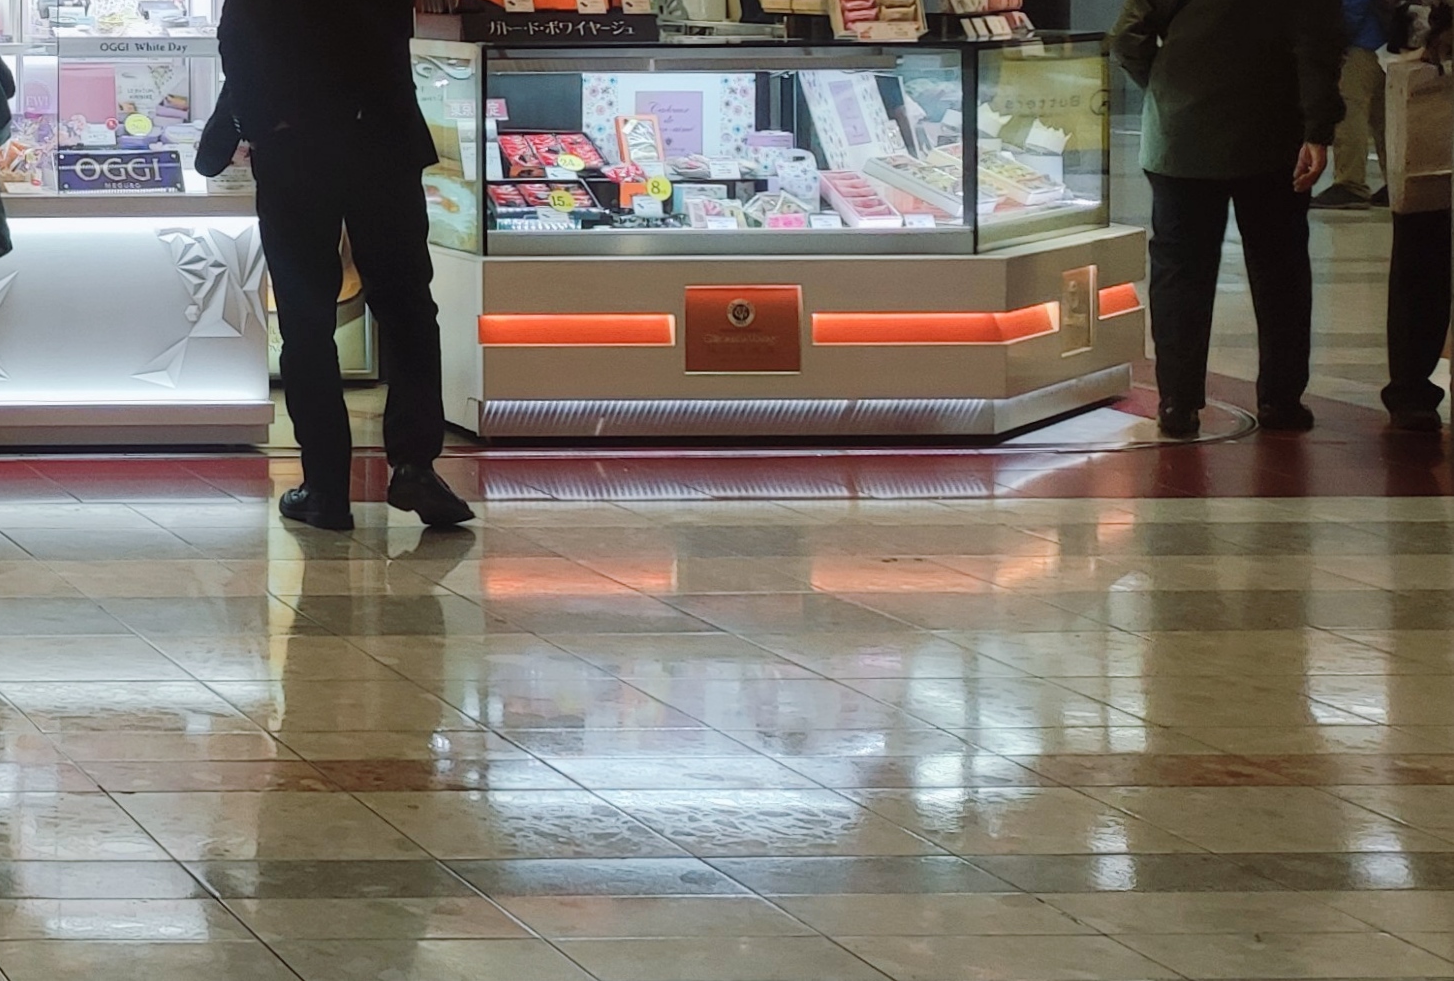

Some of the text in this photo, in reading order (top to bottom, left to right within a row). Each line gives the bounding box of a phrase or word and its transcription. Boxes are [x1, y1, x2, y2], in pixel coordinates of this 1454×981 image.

[100, 42, 188, 54] OGGI White Day
[74, 158, 163, 181] OGGI
